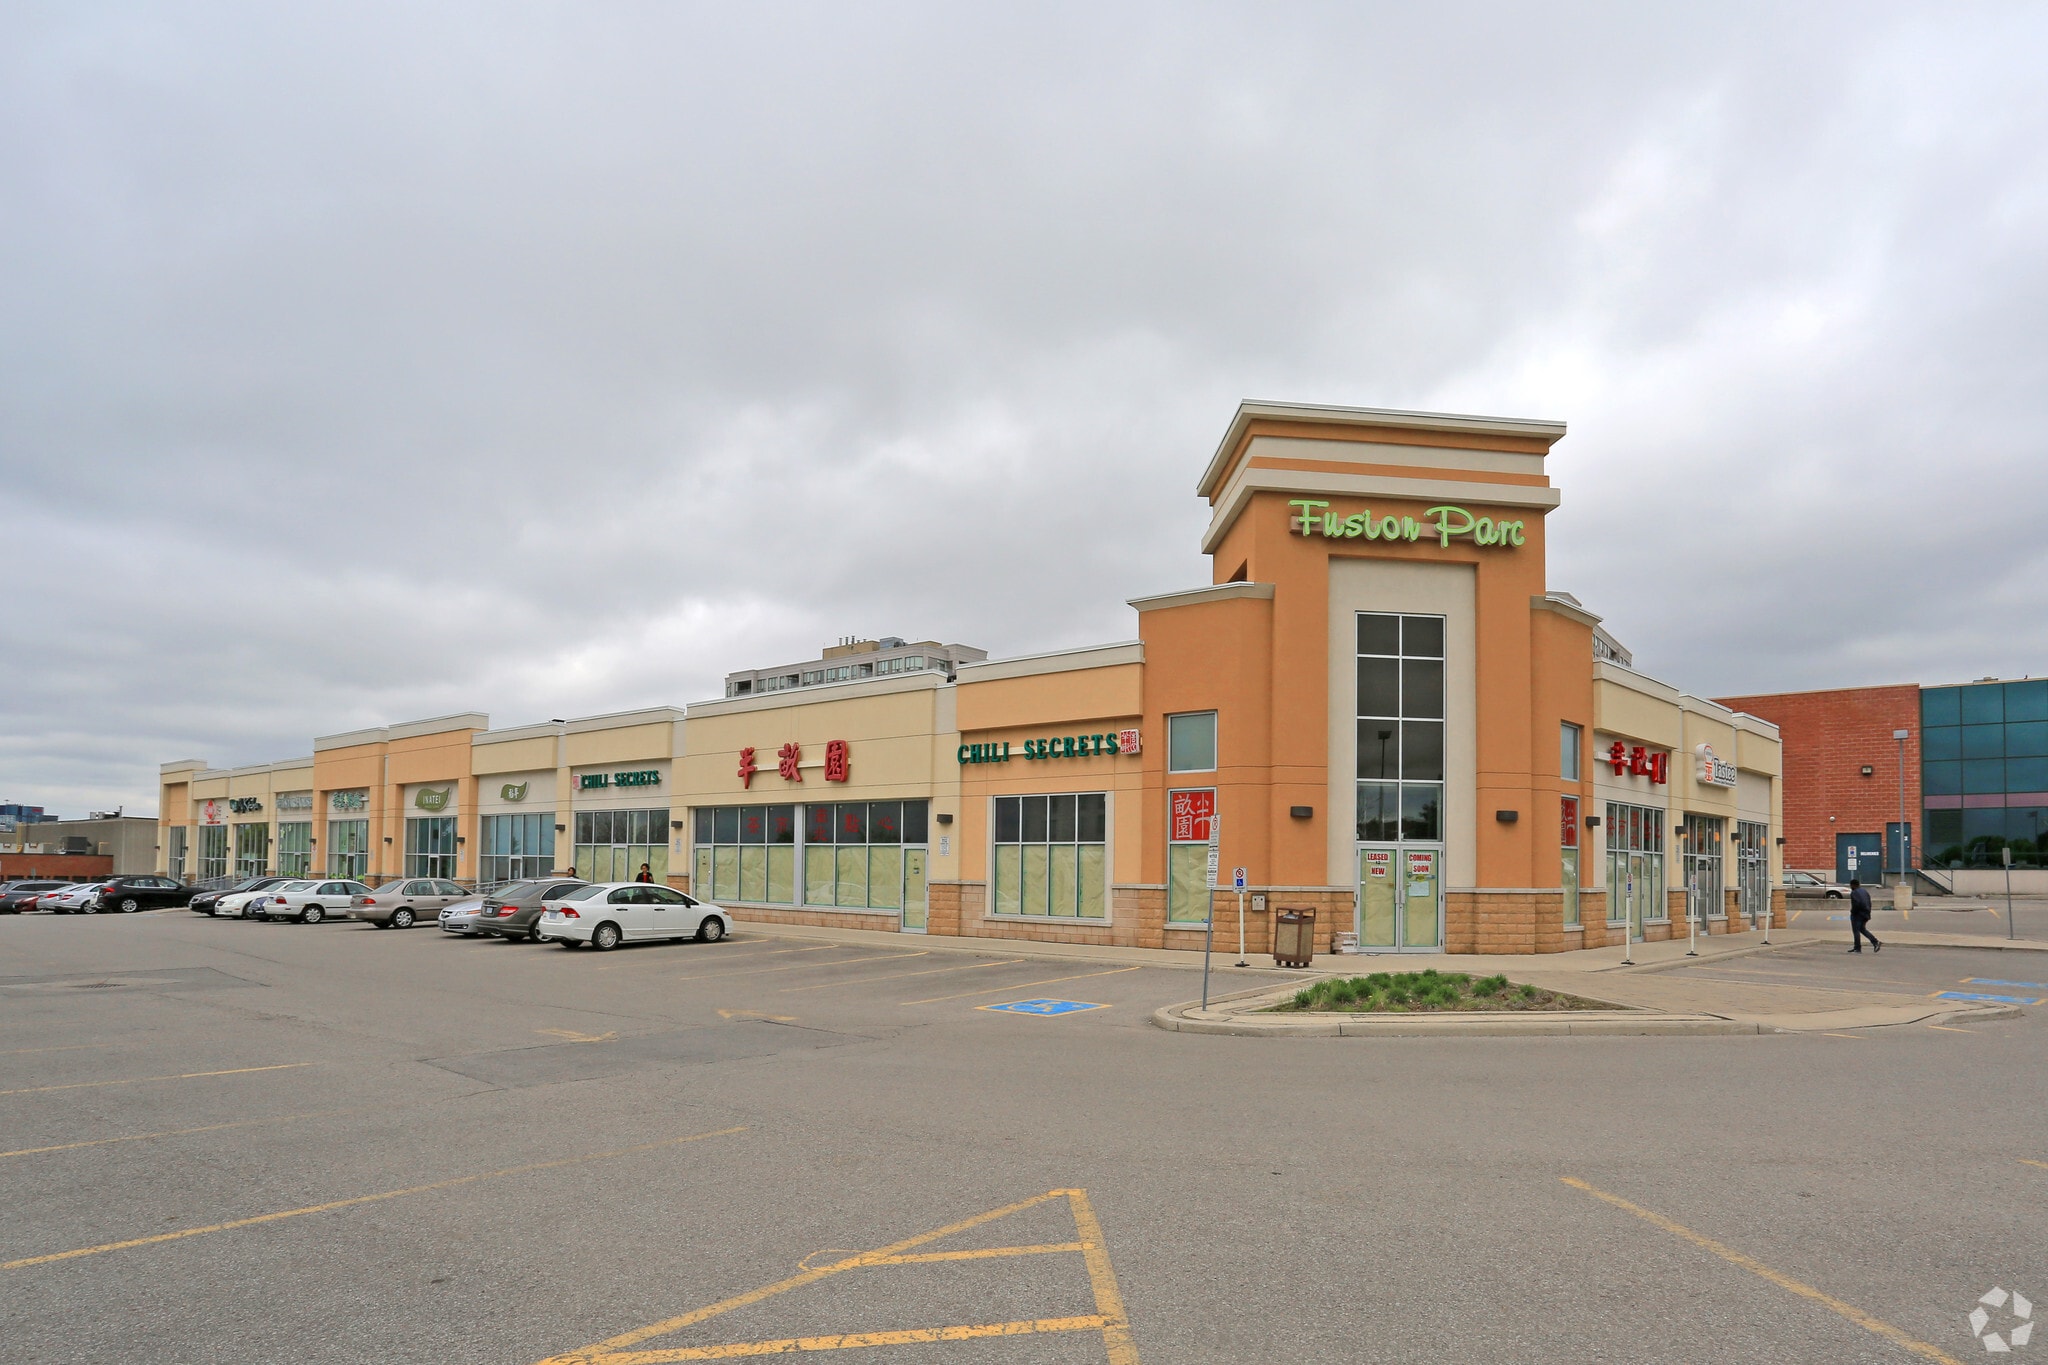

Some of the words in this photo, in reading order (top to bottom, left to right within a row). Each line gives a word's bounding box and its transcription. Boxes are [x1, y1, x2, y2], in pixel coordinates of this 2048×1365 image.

[1288, 499, 1421, 542] Fusion
[1424, 505, 1526, 547] Parc
[957, 741, 1010, 764] CHILI
[1023, 732, 1118, 760] SECRETS
[581, 773, 609, 789] CHILI
[614, 770, 661, 788] SECRETS
[1367, 853, 1389, 861] LEASED
[1408, 854, 1432, 862] COMING
[1371, 867, 1385, 875] NEW
[1413, 865, 1429, 873] SOON
